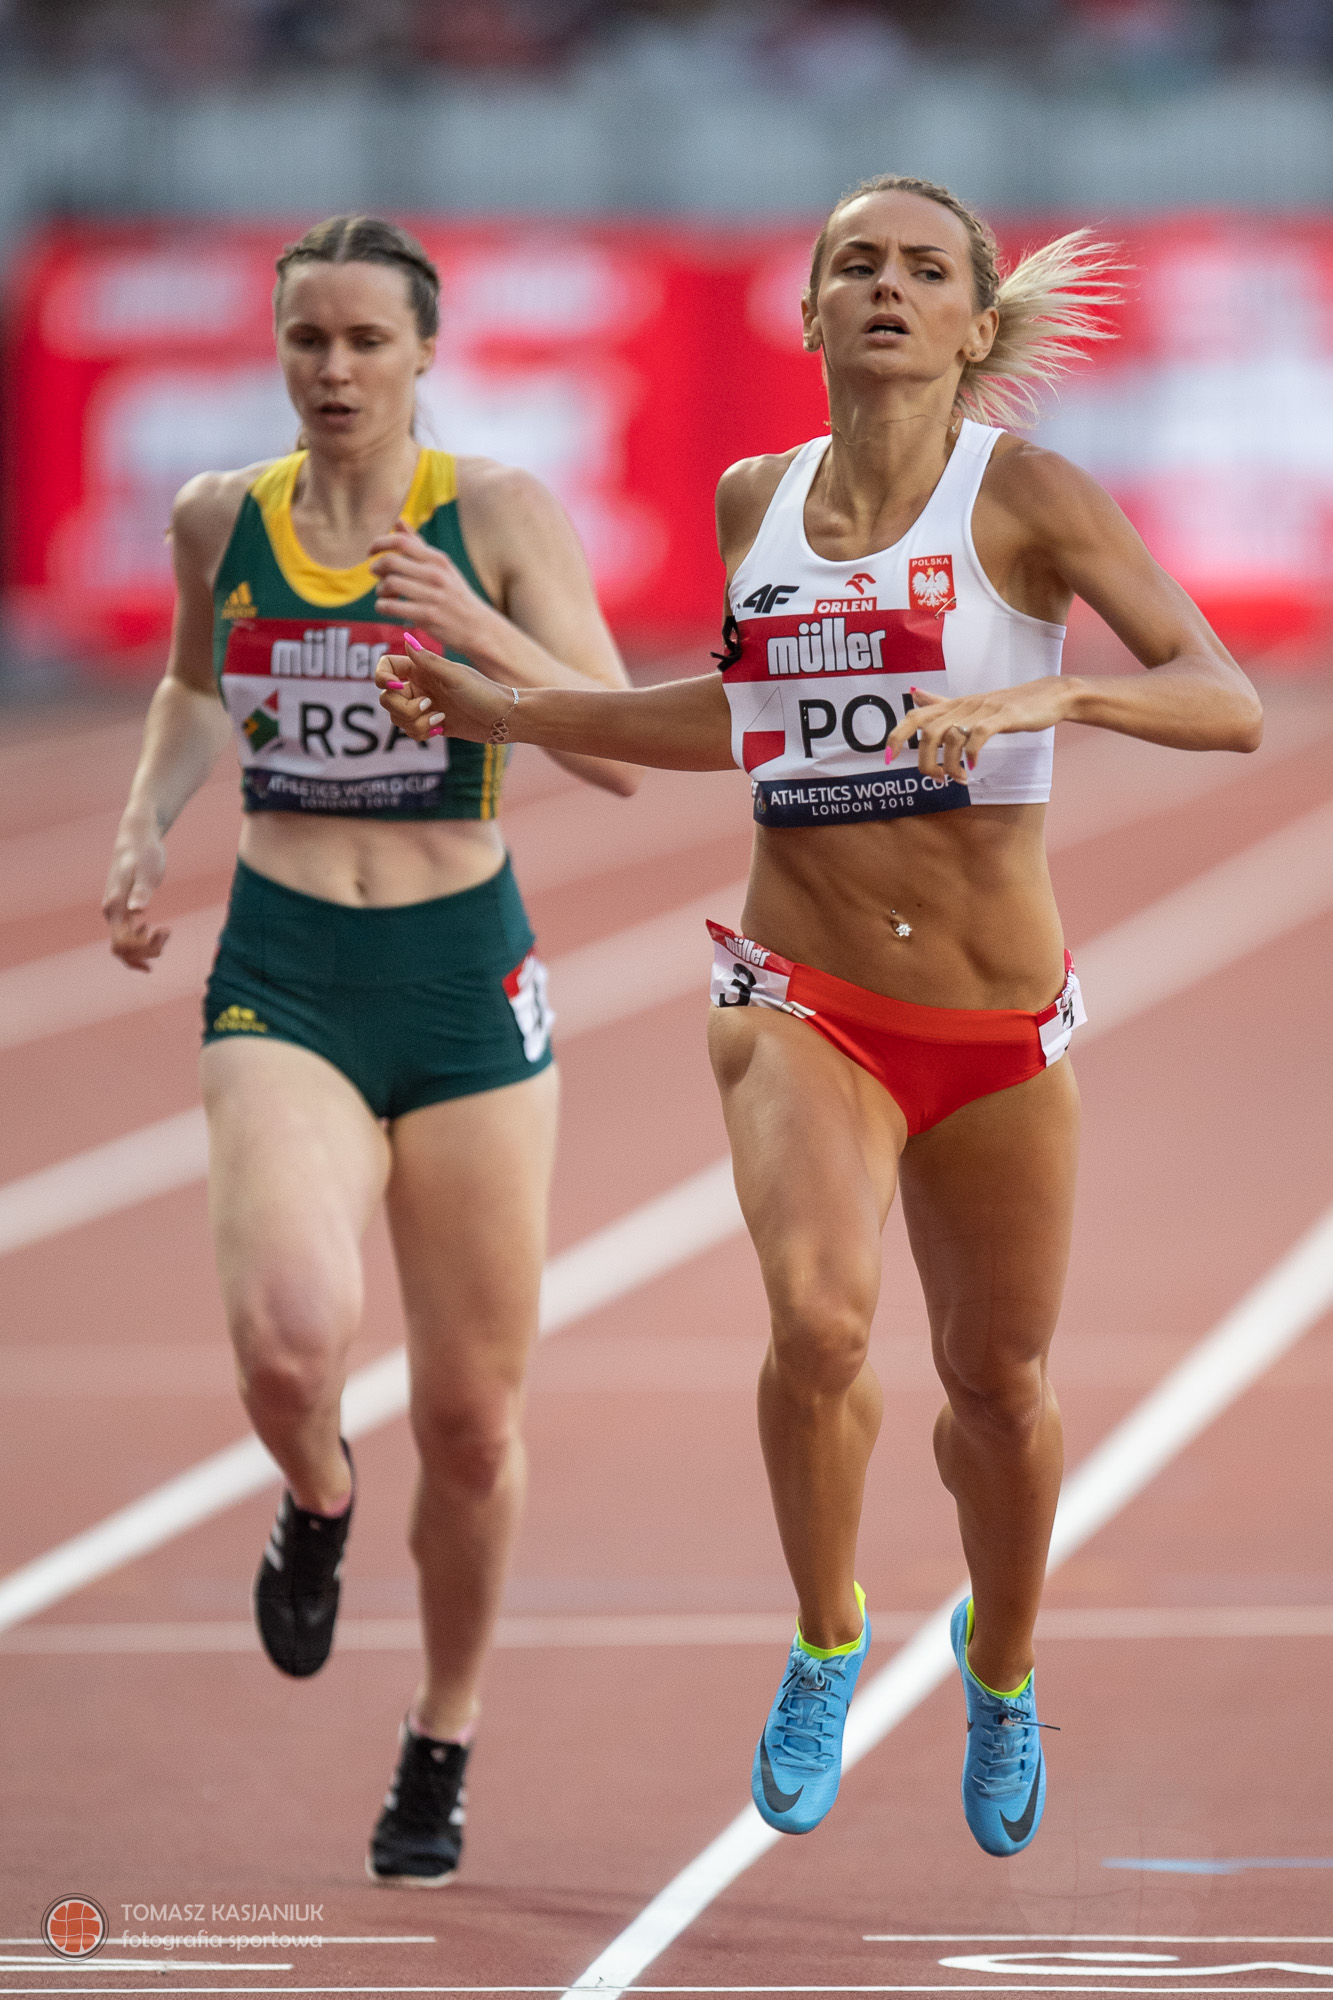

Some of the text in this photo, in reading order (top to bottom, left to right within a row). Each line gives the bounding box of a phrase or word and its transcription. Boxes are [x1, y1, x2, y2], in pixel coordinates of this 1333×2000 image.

[911, 557, 949, 567] POLSKA
[743, 584, 799, 614] 4F
[817, 600, 873, 614] ORLEN
[270, 628, 388, 678] müller
[767, 617, 886, 676] müller
[268, 774, 341, 799] ATHLETICS
[343, 778, 404, 799] WORLD
[770, 785, 851, 806] ATHLETICS
[854, 778, 918, 800] WORLD
[811, 796, 914, 816] LONDON 2018
[719, 963, 757, 1008] 3
